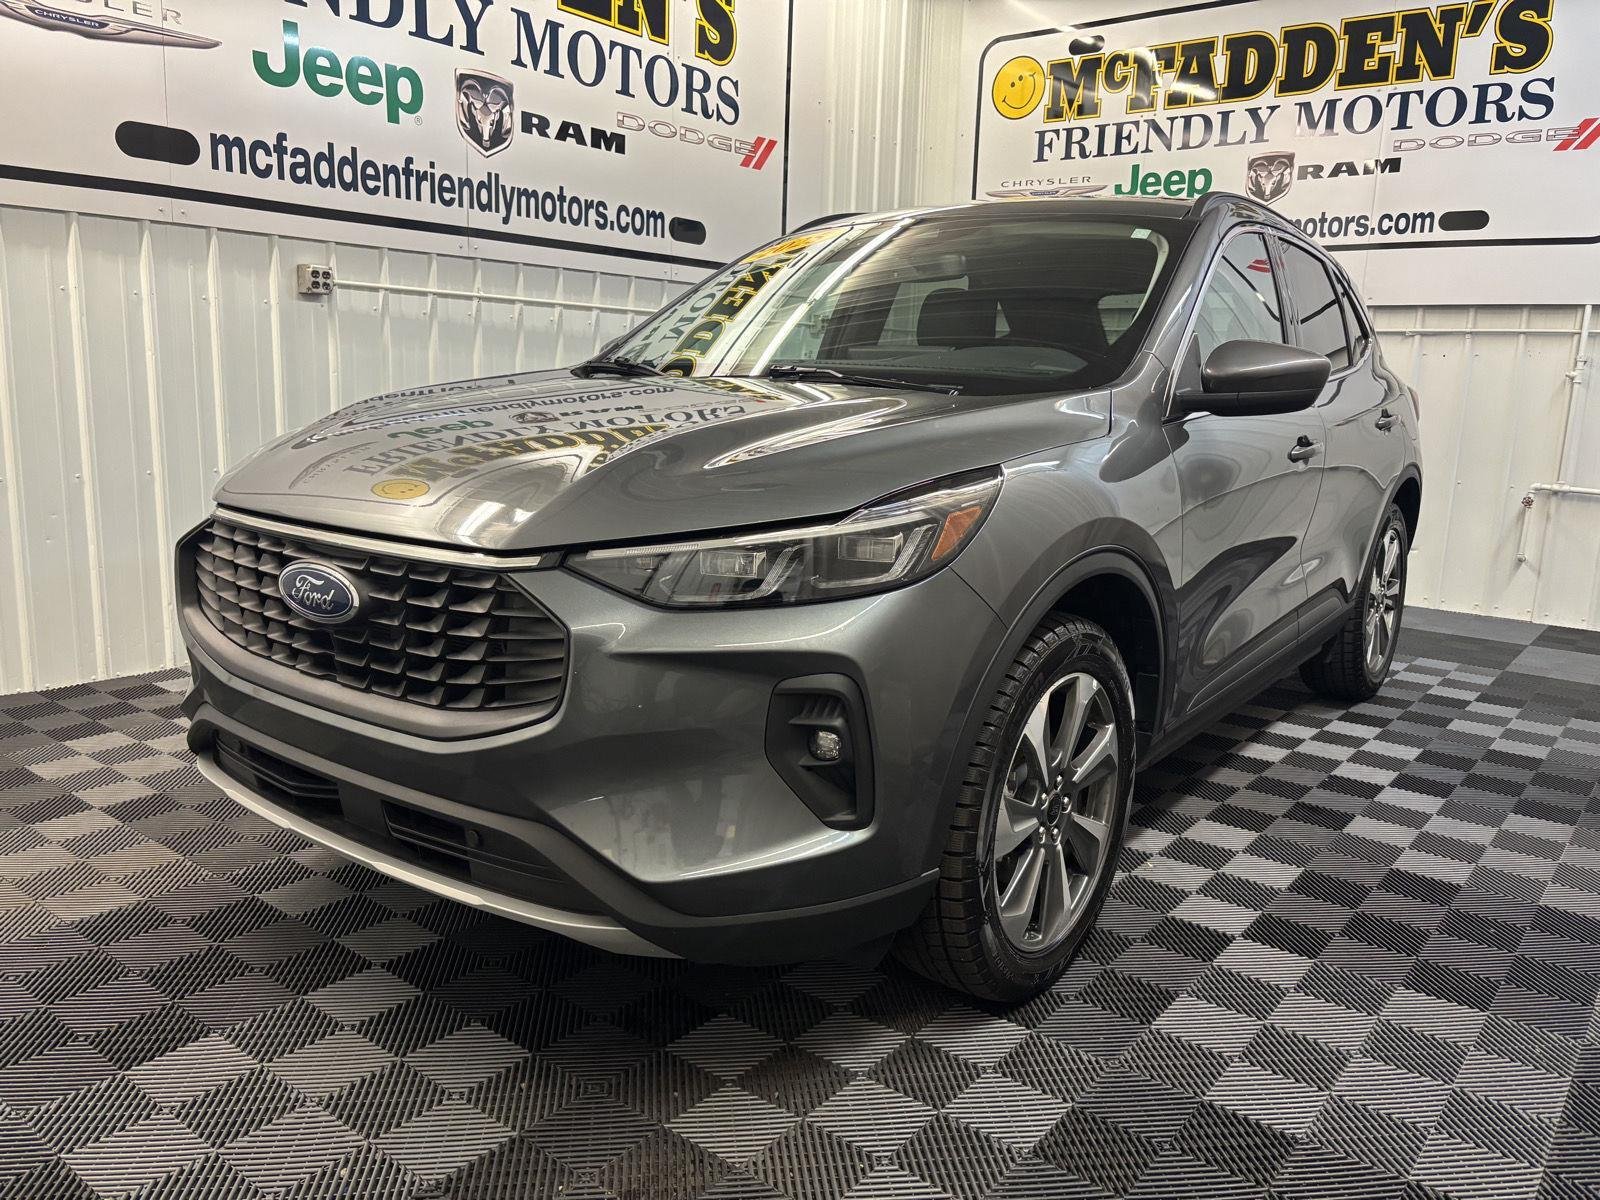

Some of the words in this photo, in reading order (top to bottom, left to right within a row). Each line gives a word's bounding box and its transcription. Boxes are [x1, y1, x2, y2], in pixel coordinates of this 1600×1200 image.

[252, 20, 424, 125] Jeep
[511, 8, 740, 126] MOTORS
[521, 111, 627, 155] RAM
[616, 111, 757, 156] DODGE
[1032, 105, 1281, 163] FRIENDLY
[1294, 77, 1556, 138] MOTORS
[1392, 126, 1581, 152] DODGE
[209, 132, 665, 239] mcfaddenfriendlymotors.com
[1000, 176, 1092, 188] CHRYSLER
[1114, 163, 1213, 198] Jeep
[1297, 157, 1402, 181] RAM
[291, 574, 336, 611] Ford
